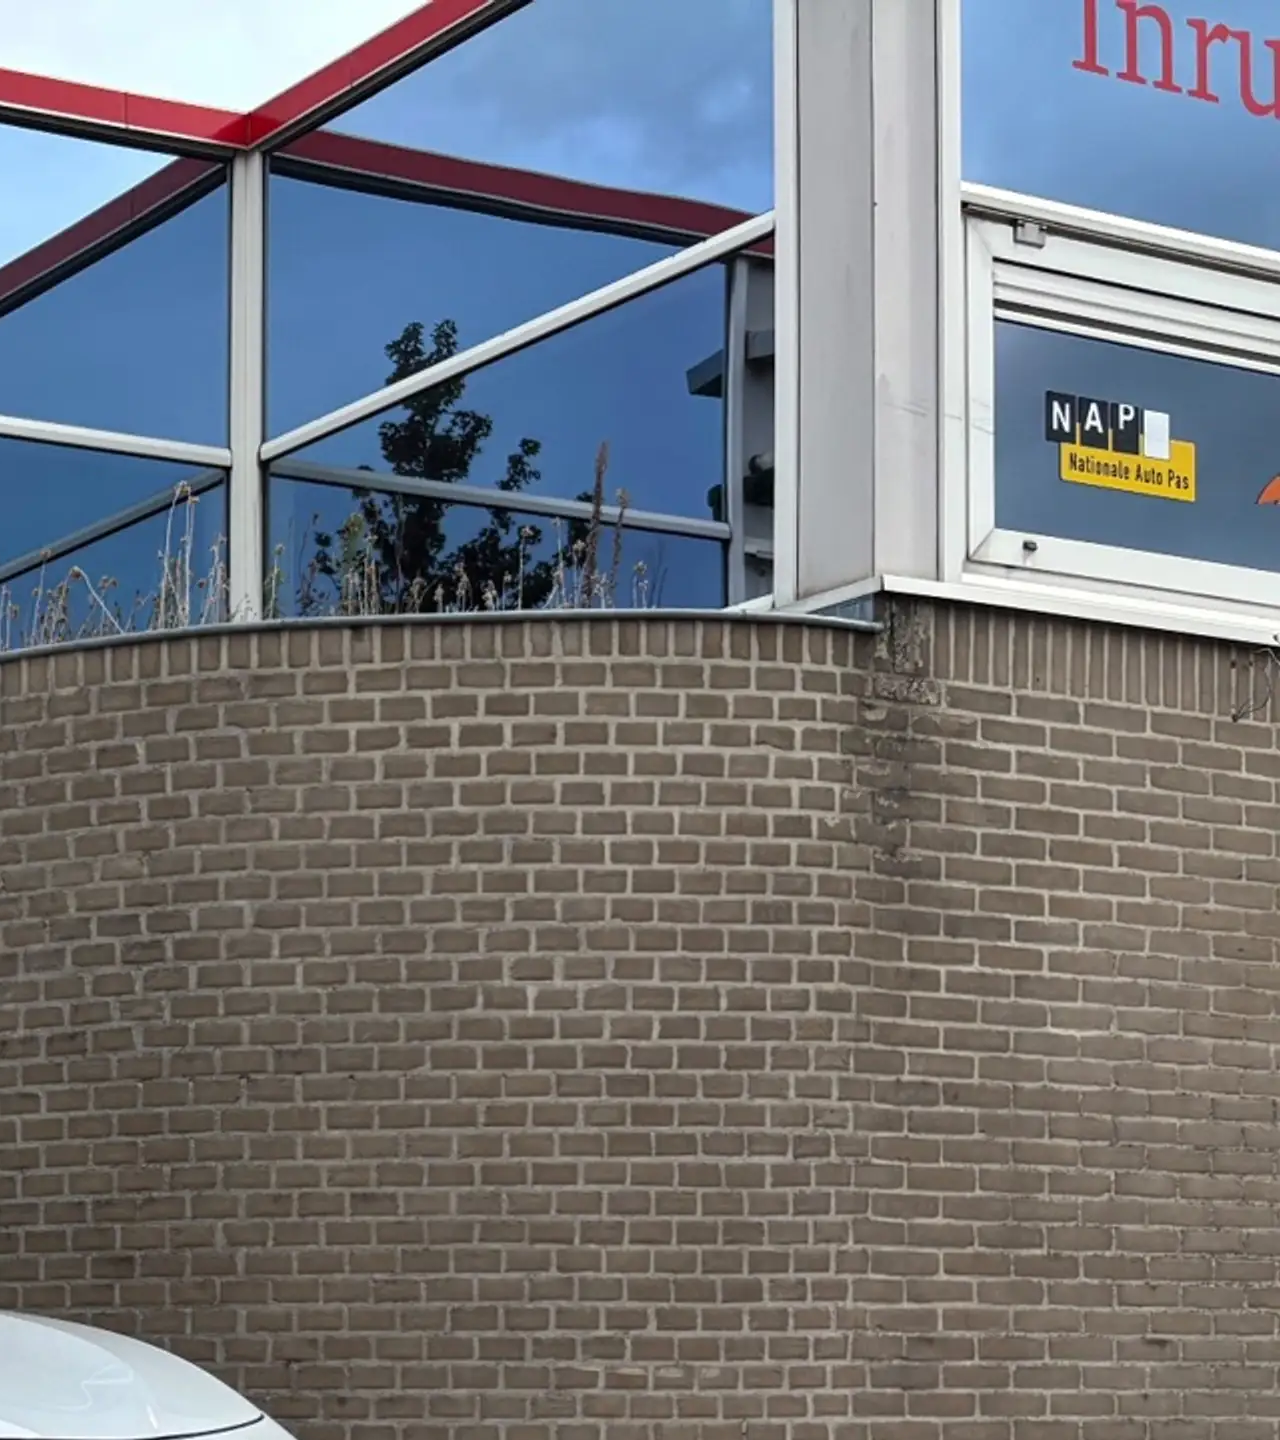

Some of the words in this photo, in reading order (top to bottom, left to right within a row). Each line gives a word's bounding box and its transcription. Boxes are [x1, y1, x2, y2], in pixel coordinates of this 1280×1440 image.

[1052, 400, 1135, 434] NAP
[1069, 452, 1131, 480] Nationale
[1135, 463, 1163, 486] Auto
[1167, 469, 1189, 490] Pas
